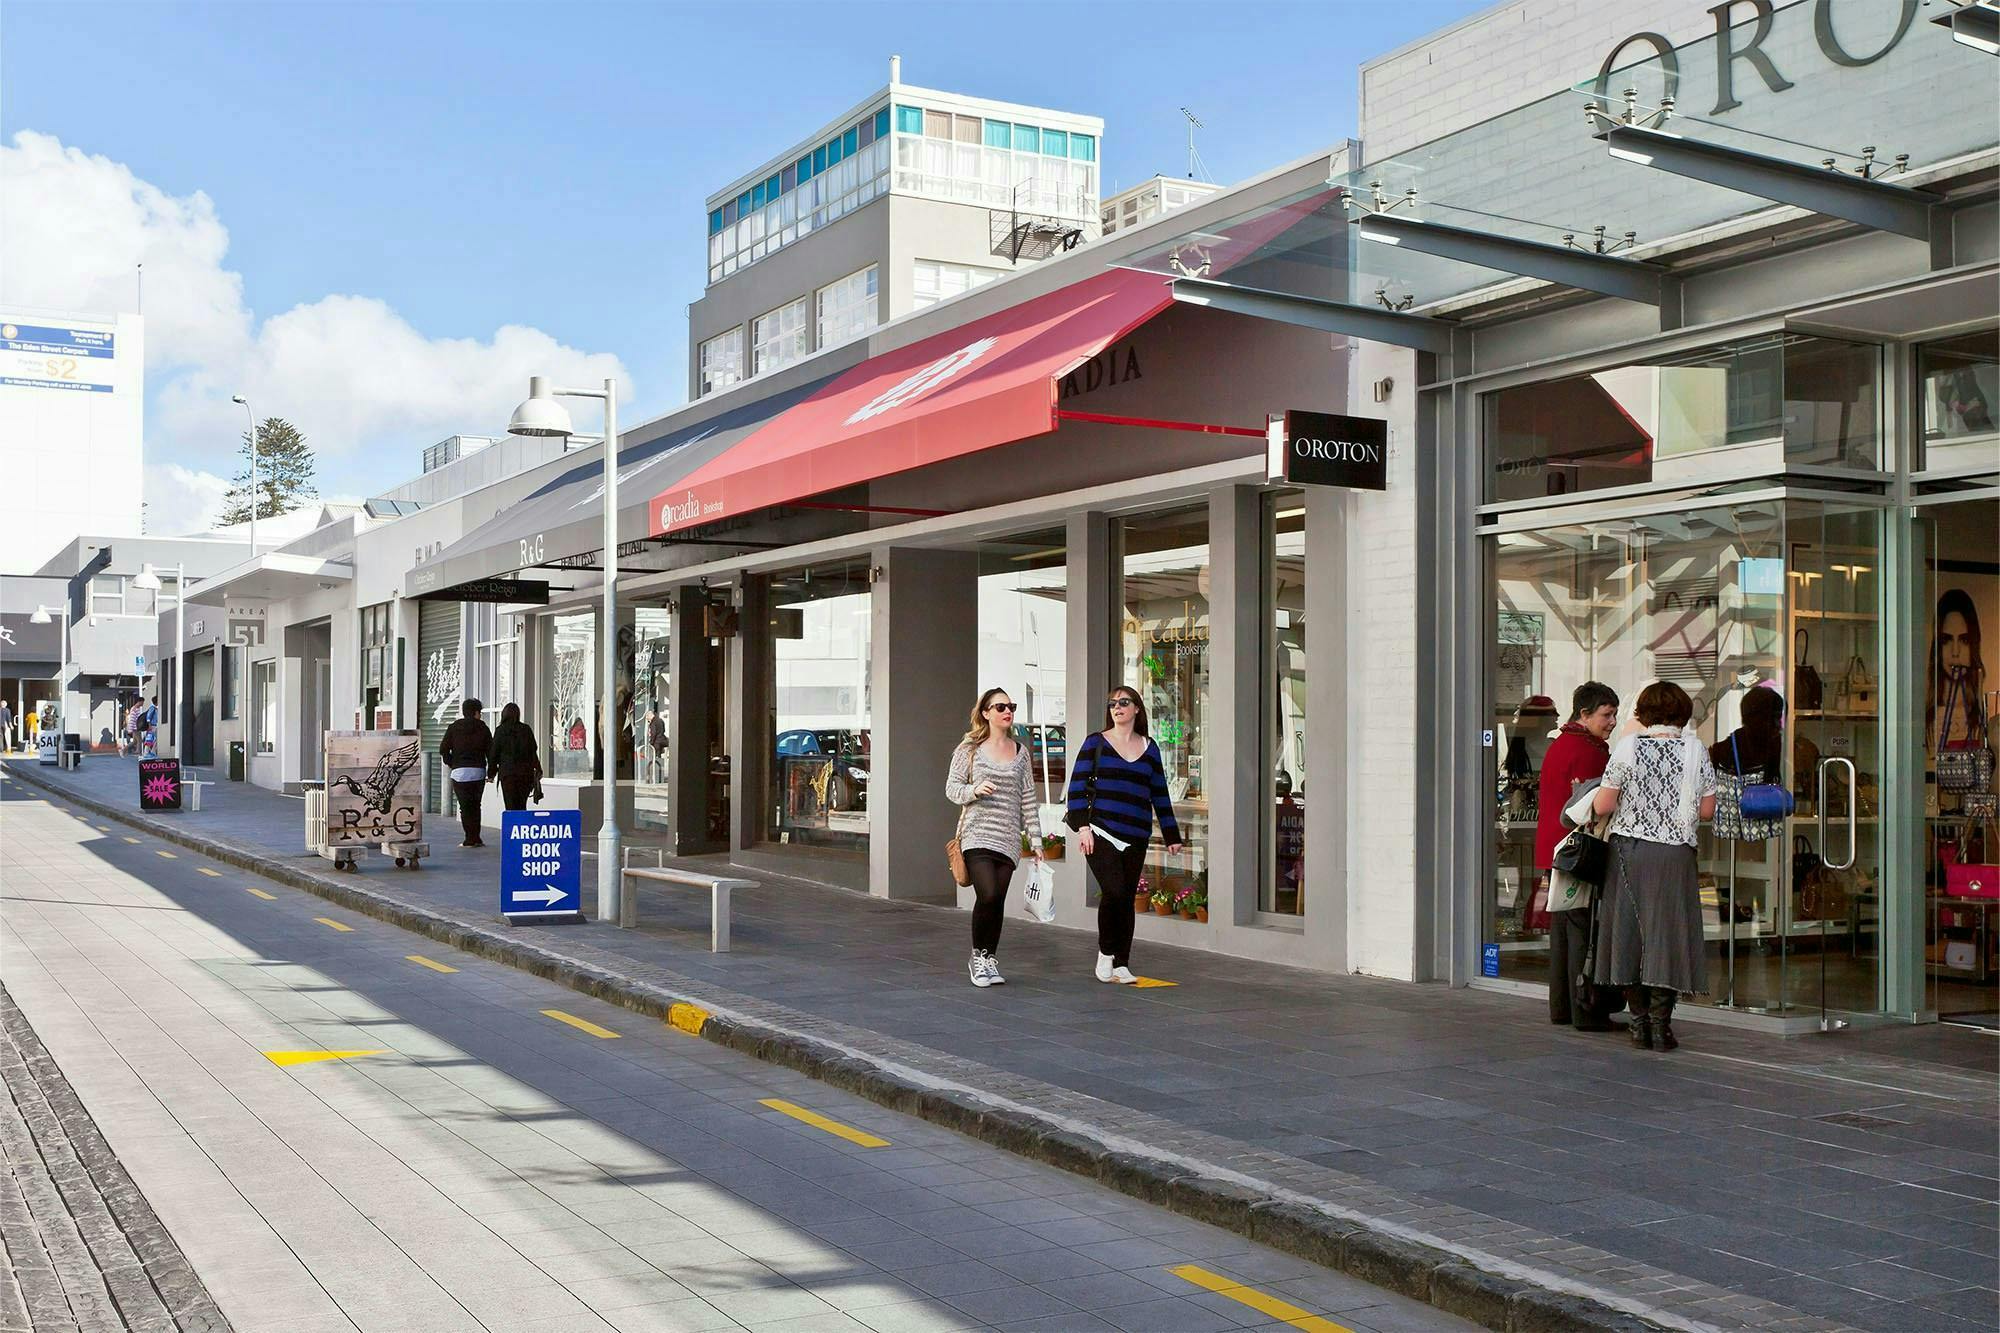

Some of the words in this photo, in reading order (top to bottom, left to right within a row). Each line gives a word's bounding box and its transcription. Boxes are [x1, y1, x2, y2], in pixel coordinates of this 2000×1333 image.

[46, 358, 78, 380] $2
[1295, 437, 1379, 464] OROTON
[661, 491, 700, 530] arcadia
[519, 534, 545, 566] R&G
[489, 583, 517, 597] Reign
[229, 607, 265, 615] AREA
[235, 625, 259, 647] 51
[1832, 737, 1849, 745] PUSH
[142, 762, 177, 770] WORLD
[150, 785, 168, 793] SALE
[510, 824, 573, 840] ARCADIA
[521, 842, 561, 858] BOOK
[522, 861, 561, 877] SHOP
